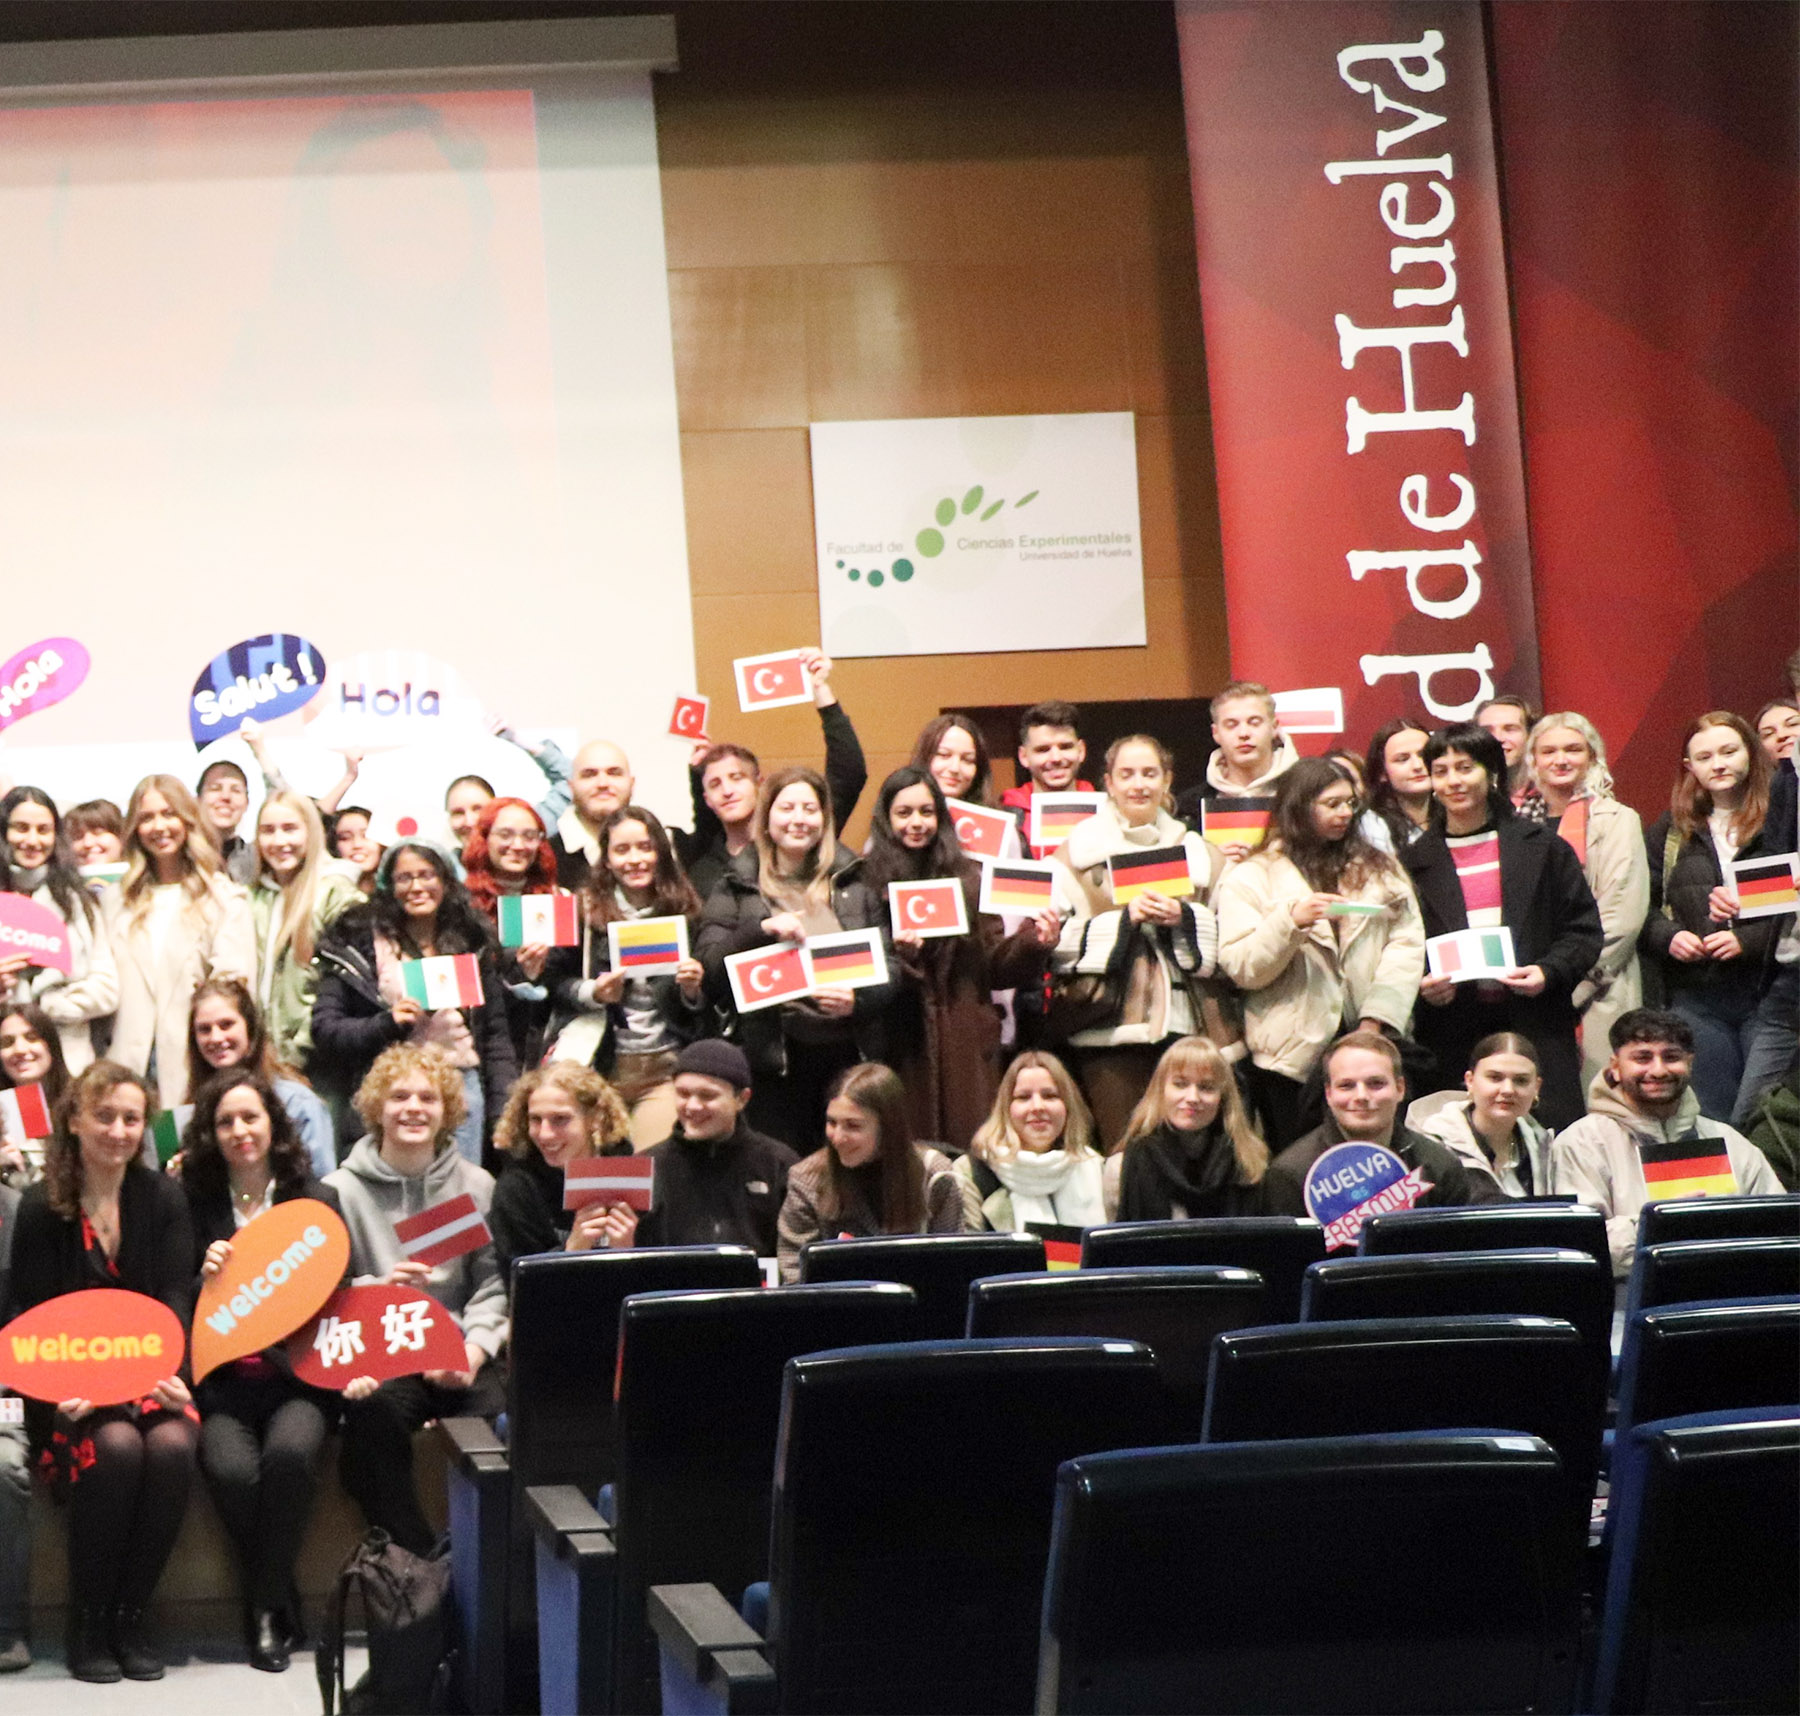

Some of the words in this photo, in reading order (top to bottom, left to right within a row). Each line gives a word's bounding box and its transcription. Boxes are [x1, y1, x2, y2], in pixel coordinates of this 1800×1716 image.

[1324, 29, 1478, 455] Huelva
[826, 540, 883, 555] Facultad
[956, 536, 1014, 551] Ciencias
[1018, 531, 1132, 549] Experimentales
[1019, 549, 1080, 561] Universidad
[1097, 547, 1132, 558] Huelva
[1346, 473, 1484, 620] de
[193, 662, 298, 725] Salut
[296, 652, 318, 685] !
[340, 682, 440, 716] Hola
[1310, 1152, 1392, 1203] HUELVA
[1351, 1186, 1370, 1201] es
[206, 1224, 328, 1336] Welcome
[11, 1333, 163, 1363] Welcome
